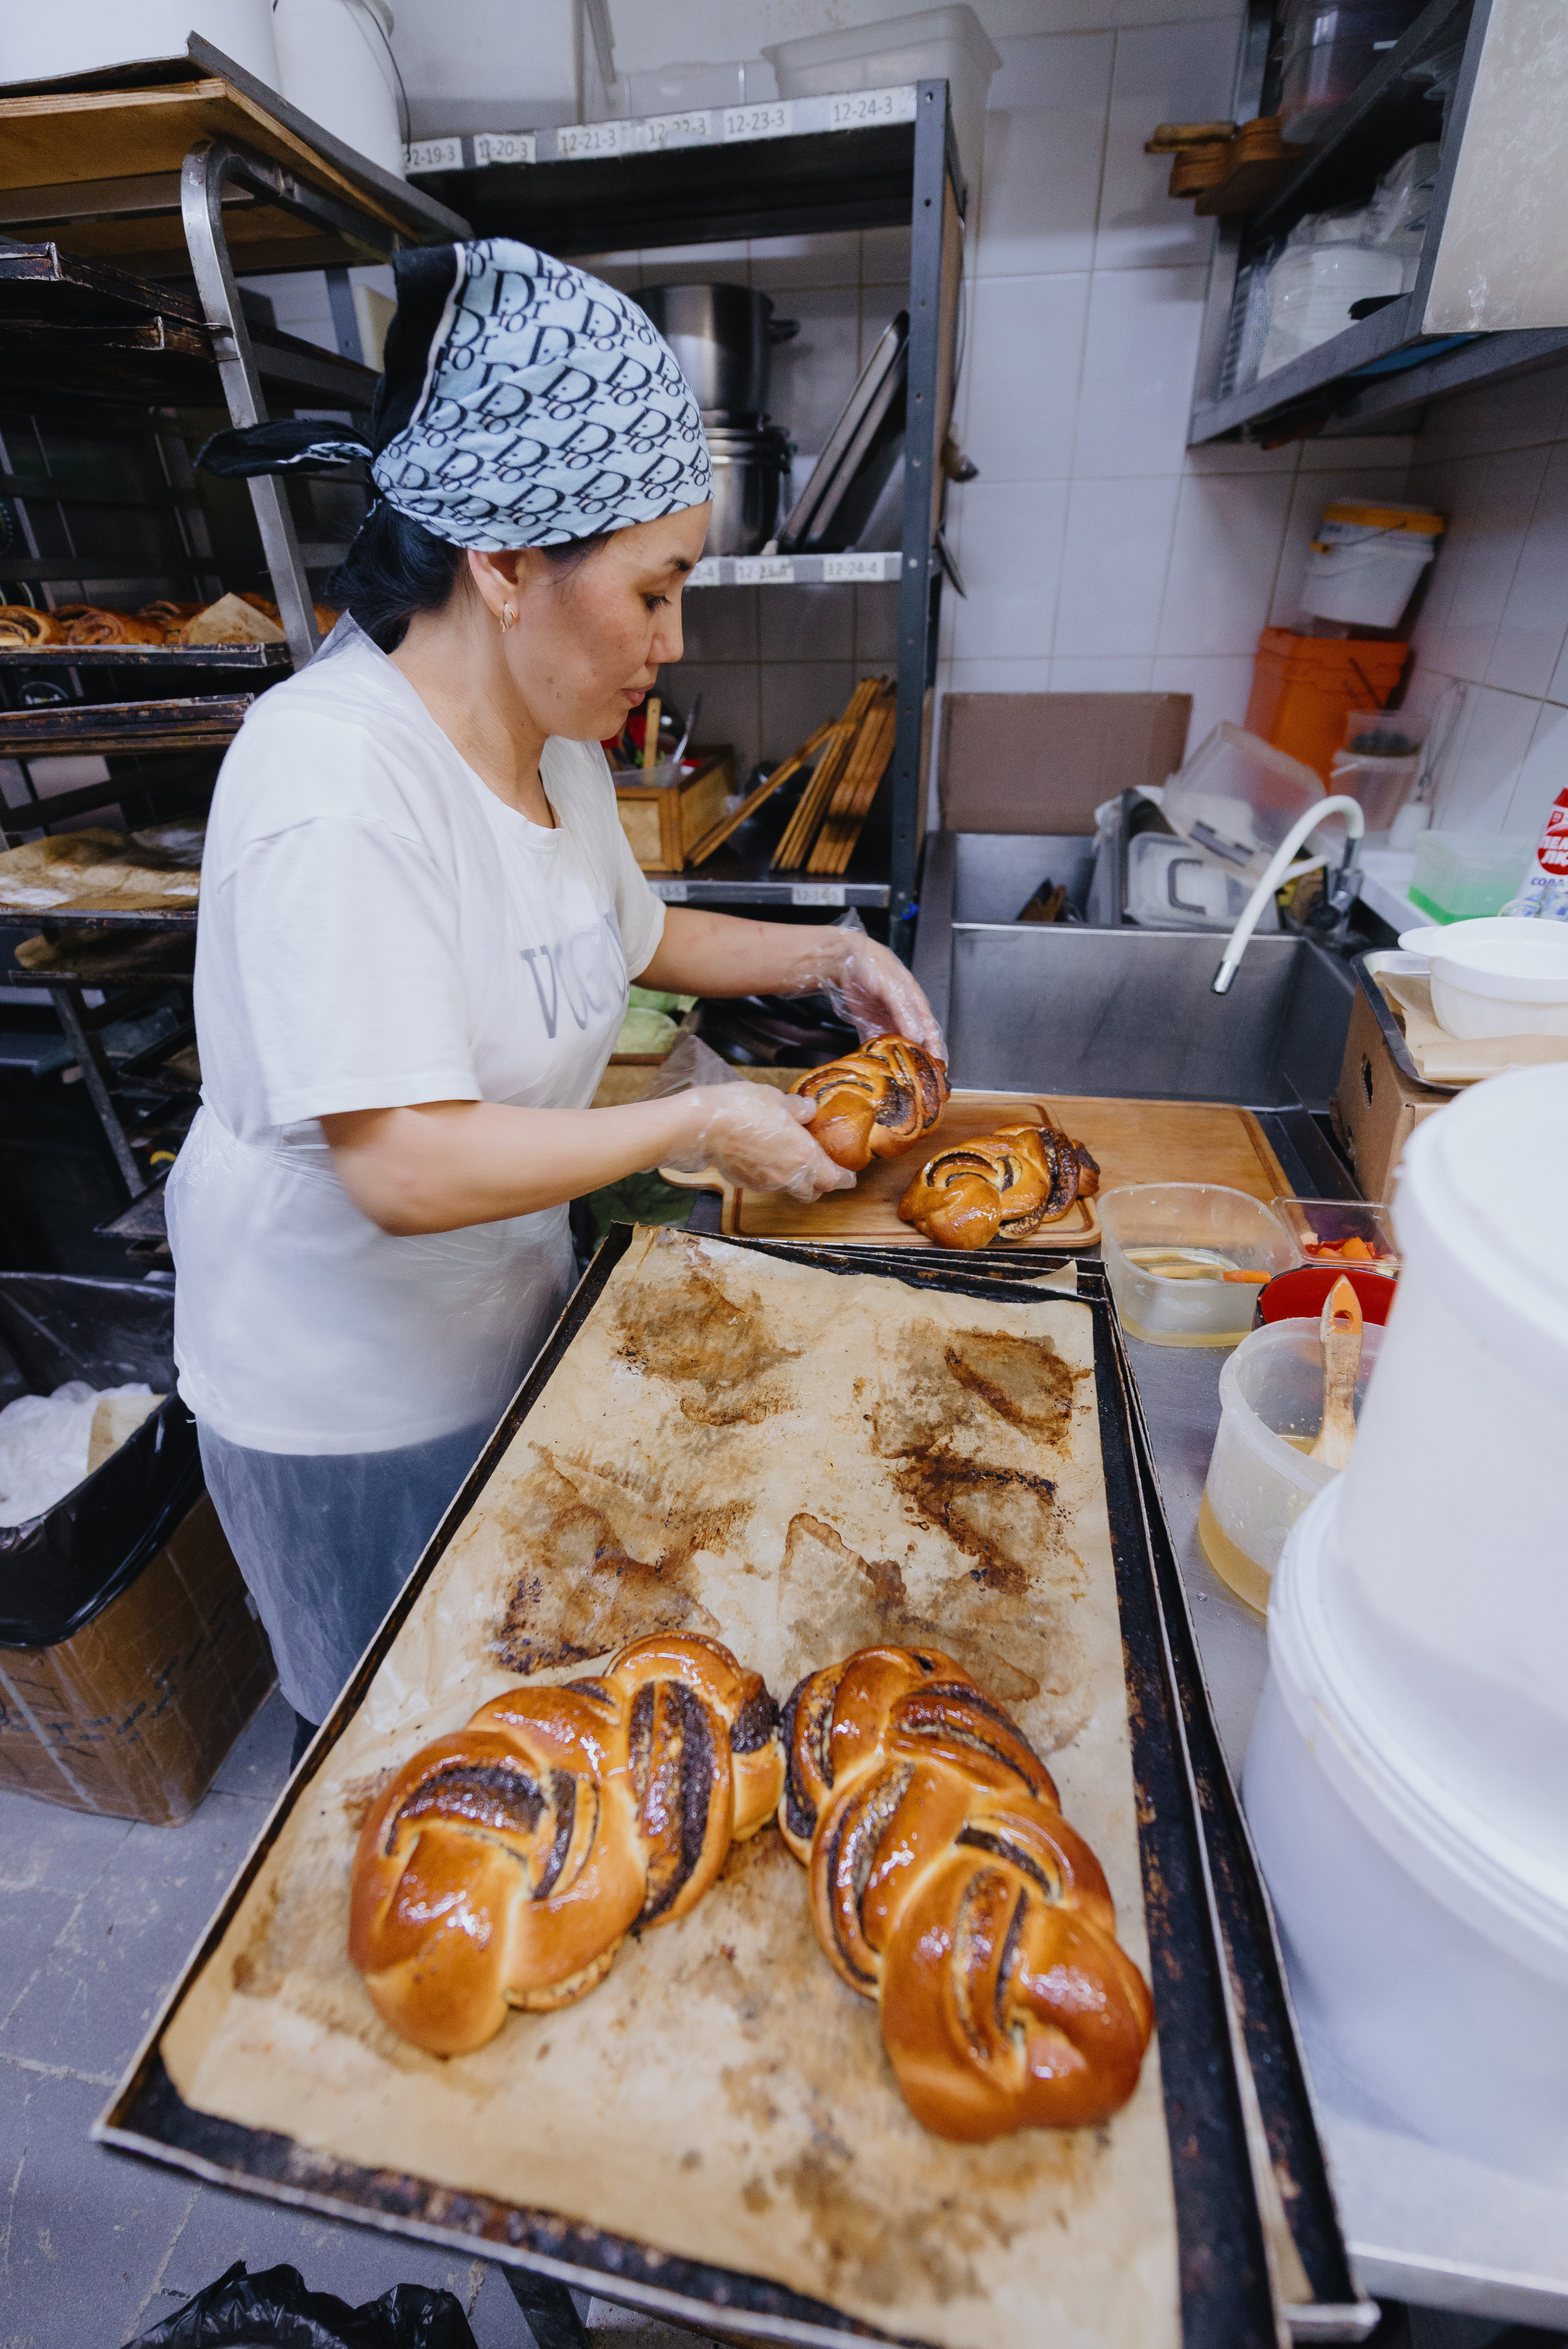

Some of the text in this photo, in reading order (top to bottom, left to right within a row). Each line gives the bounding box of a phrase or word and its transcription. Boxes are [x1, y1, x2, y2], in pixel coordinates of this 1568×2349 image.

[728, 108, 785, 134] 12-23-3
[833, 96, 893, 122] 12-24-3
[562, 129, 617, 153] 12-21-3
[489, 268, 550, 333] Dior
[579, 295, 634, 352] Dior
[533, 366, 605, 421] Dior
[602, 352, 660, 406] Dior
[470, 381, 540, 434] Dior
[617, 405, 677, 454] Dior
[487, 433, 556, 483] Dior
[552, 420, 623, 470] Dior
[432, 447, 489, 492] Dior
[567, 469, 636, 515] Dior
[635, 453, 689, 500] Dior
[500, 482, 571, 527] Dior
[827, 561, 877, 576] 12-24-4
